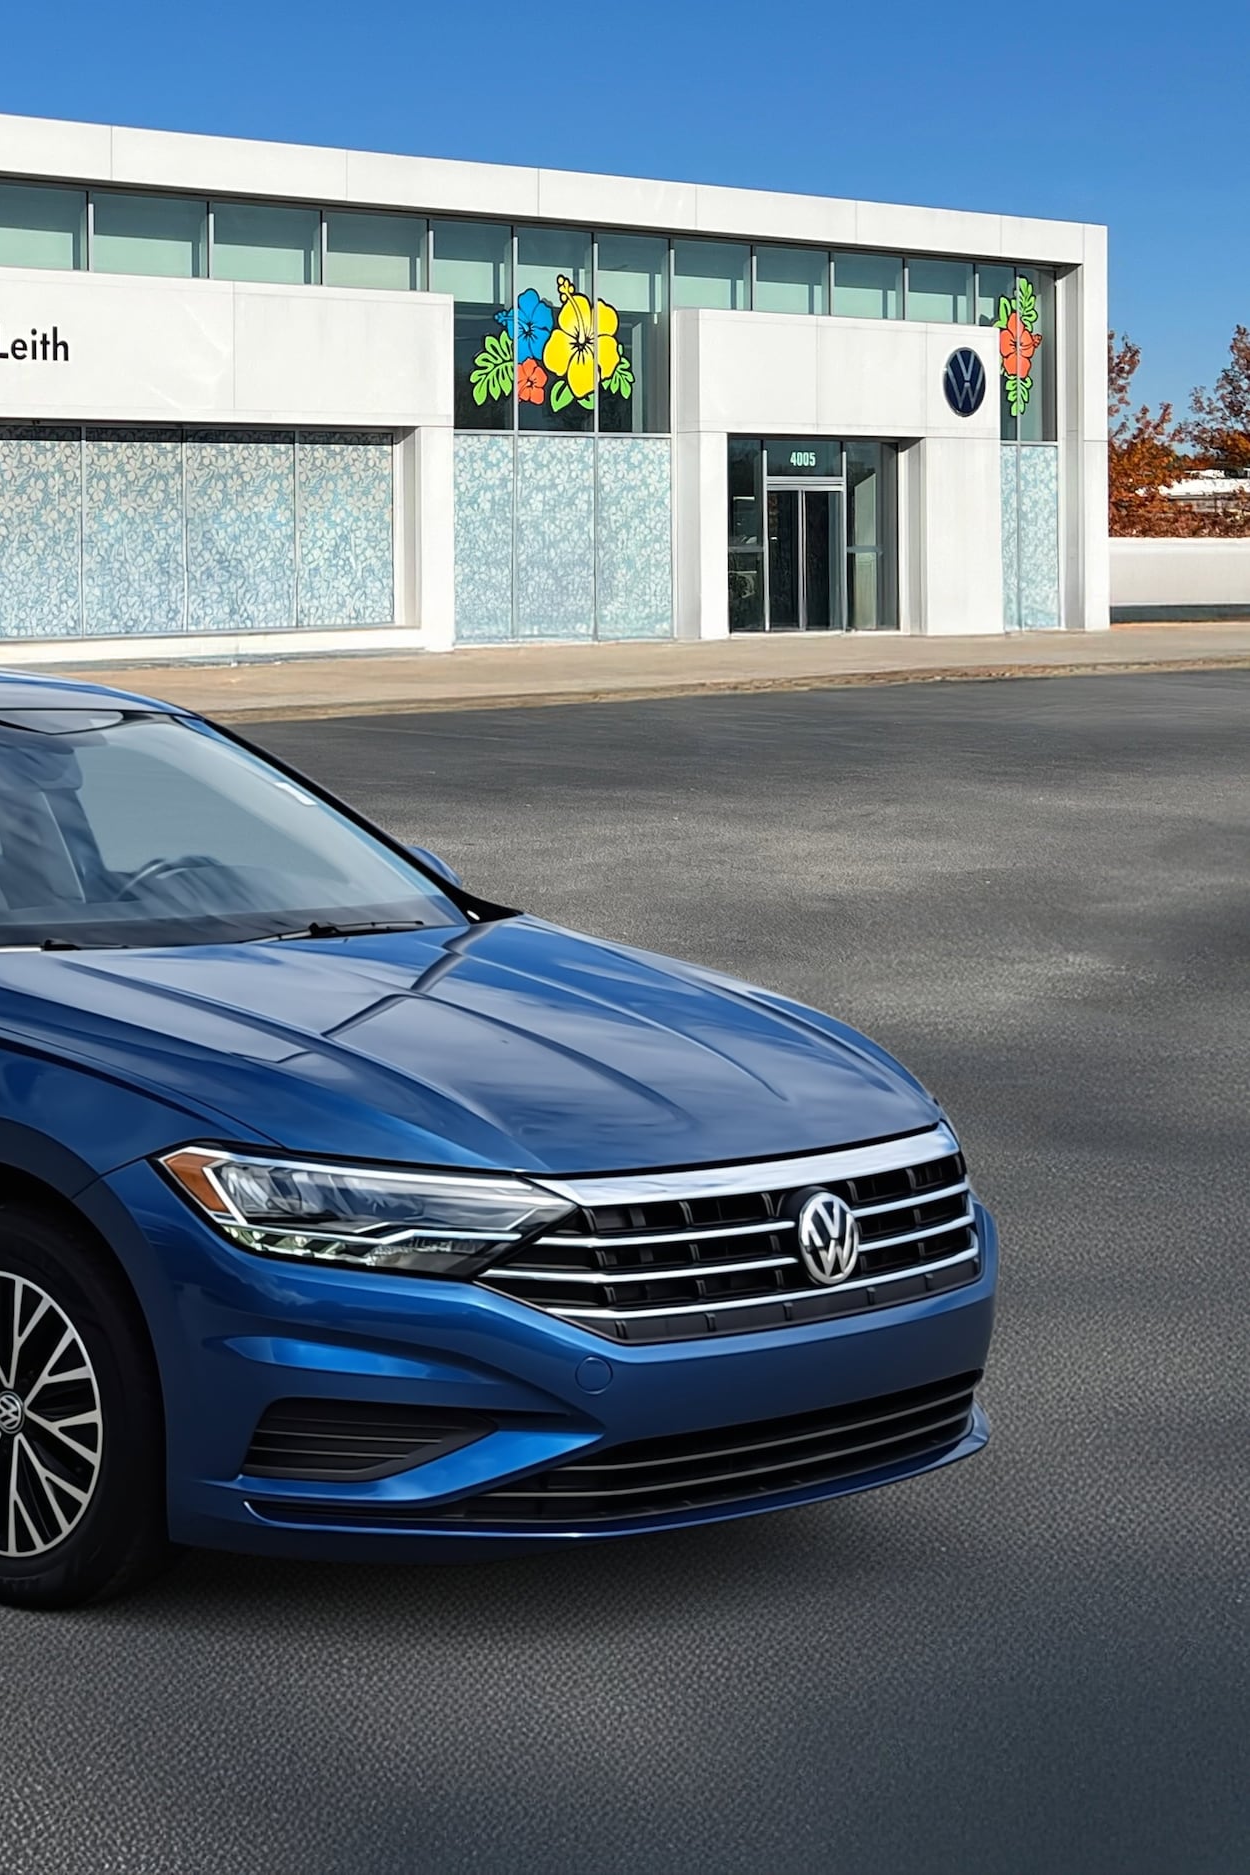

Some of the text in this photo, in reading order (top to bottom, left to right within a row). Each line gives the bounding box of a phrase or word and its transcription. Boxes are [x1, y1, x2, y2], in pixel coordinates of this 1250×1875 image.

[944, 348, 986, 416] VW
[790, 451, 816, 466] 4005
[800, 1193, 858, 1283] VW
